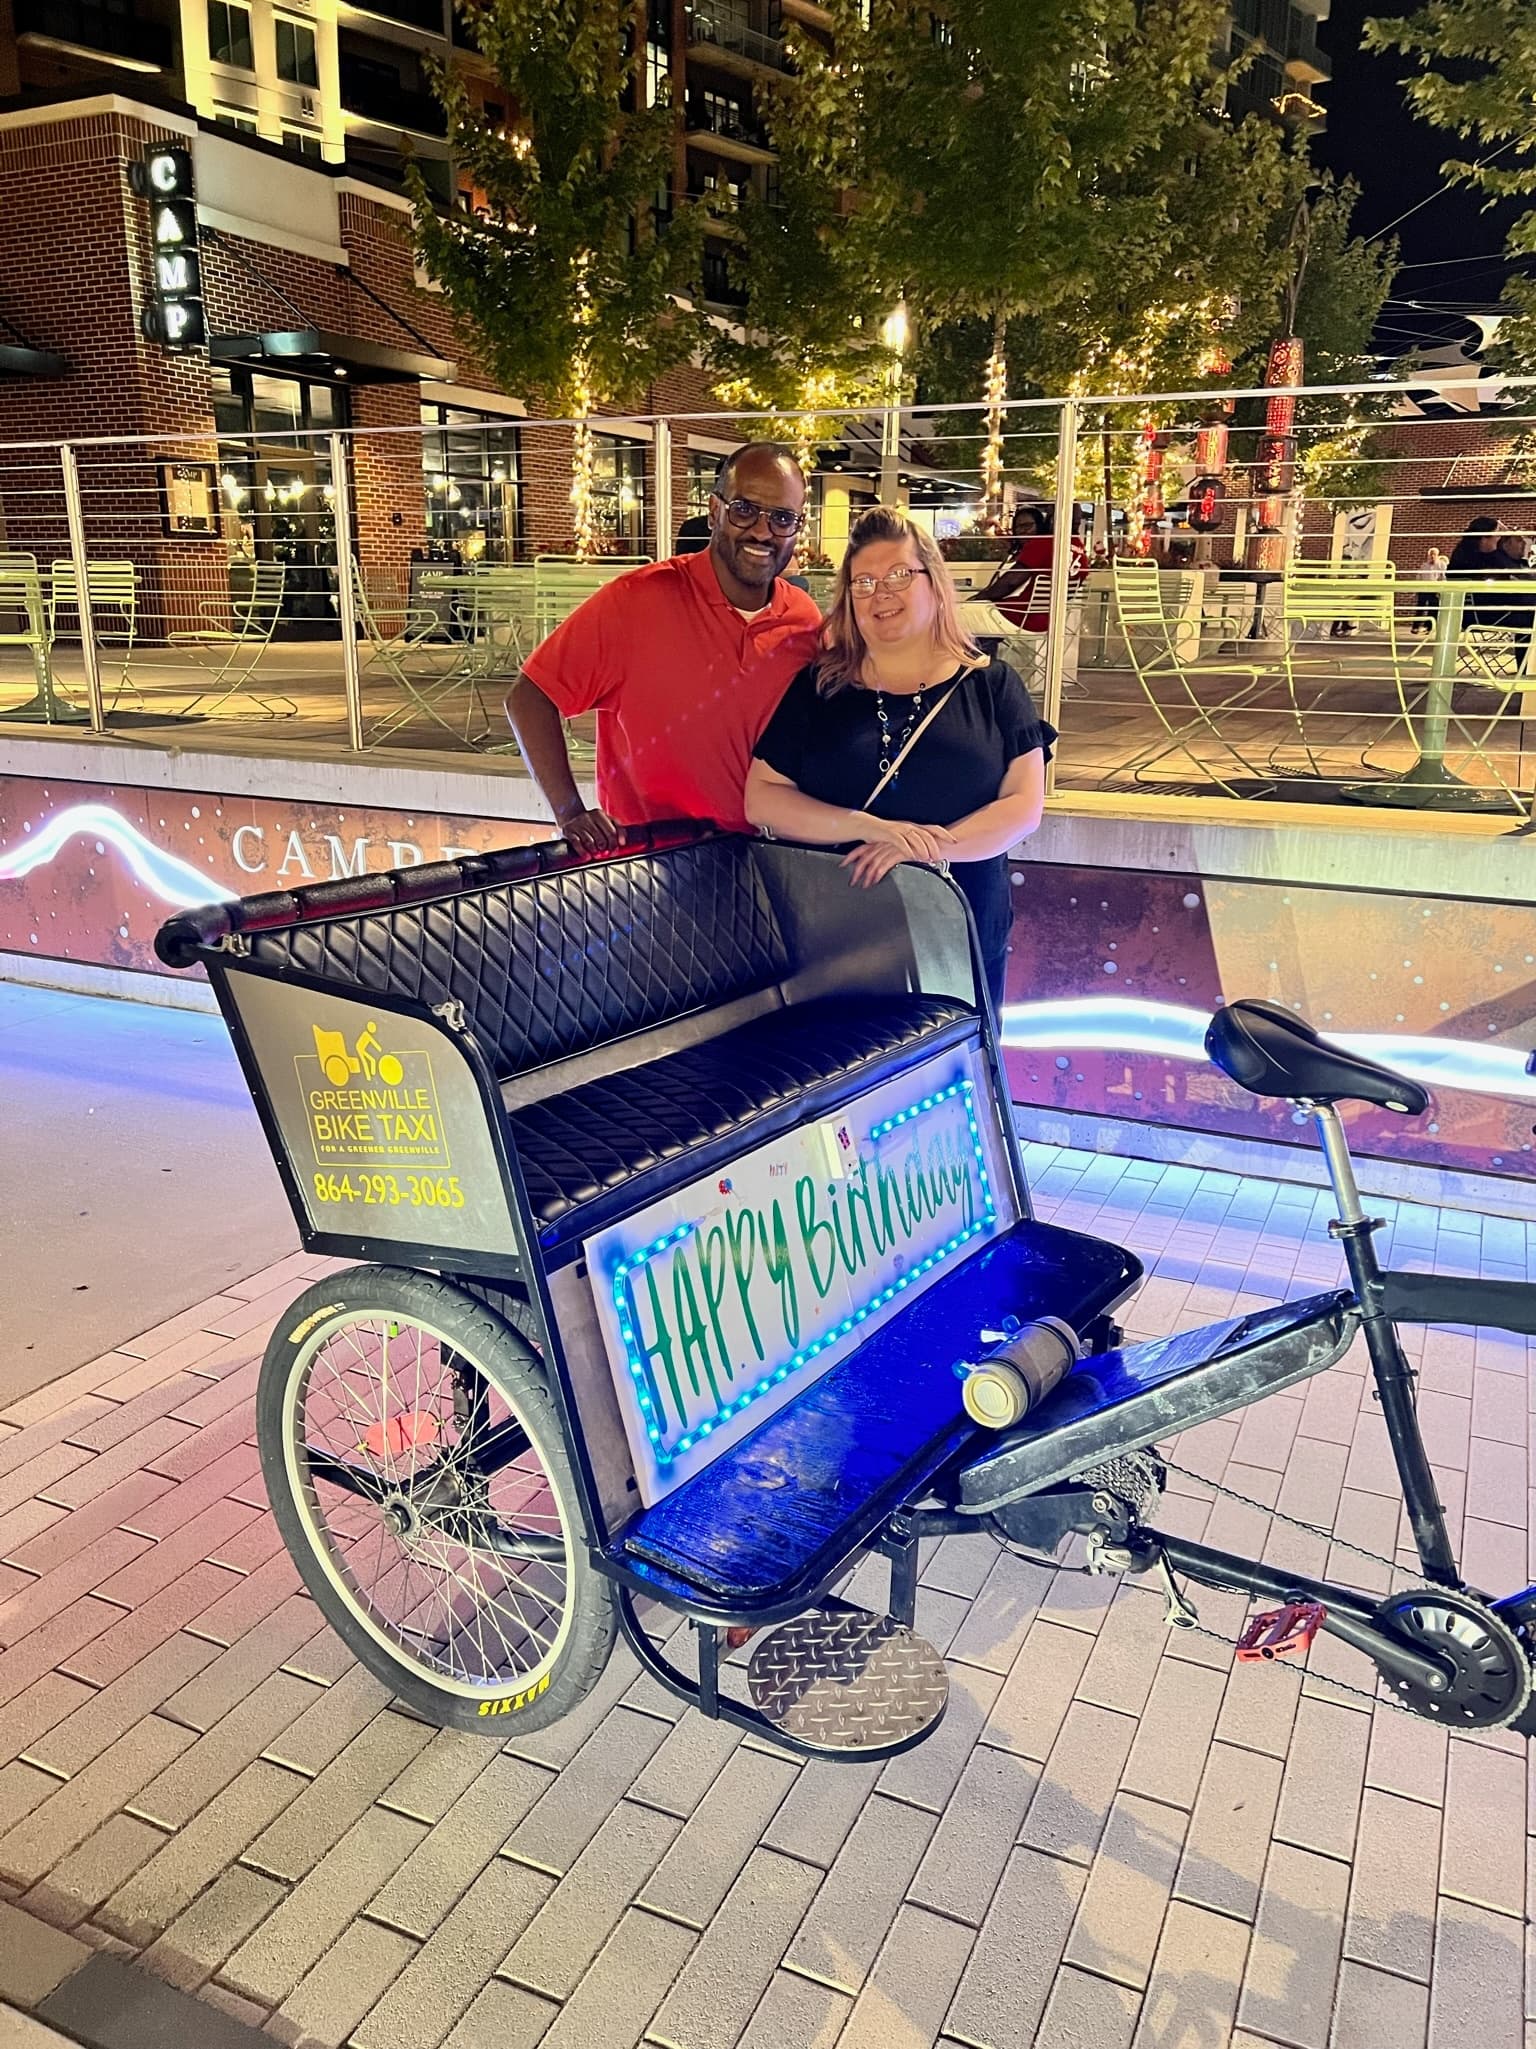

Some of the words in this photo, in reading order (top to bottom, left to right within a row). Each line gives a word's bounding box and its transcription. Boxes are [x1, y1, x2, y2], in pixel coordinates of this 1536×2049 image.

[151, 156, 188, 338] CAMP
[309, 1089, 432, 1110] GREENVILLE
[314, 1114, 374, 1141] BIKE
[377, 1114, 438, 1141] TAXI
[320, 1145, 337, 1153] FOR
[339, 1145, 345, 1153] A
[347, 1145, 385, 1153] GREENER
[387, 1146, 440, 1154] GREENVILLE
[313, 1172, 466, 1209] 864-293-3065
[478, 1671, 551, 1717] MAXXIS
